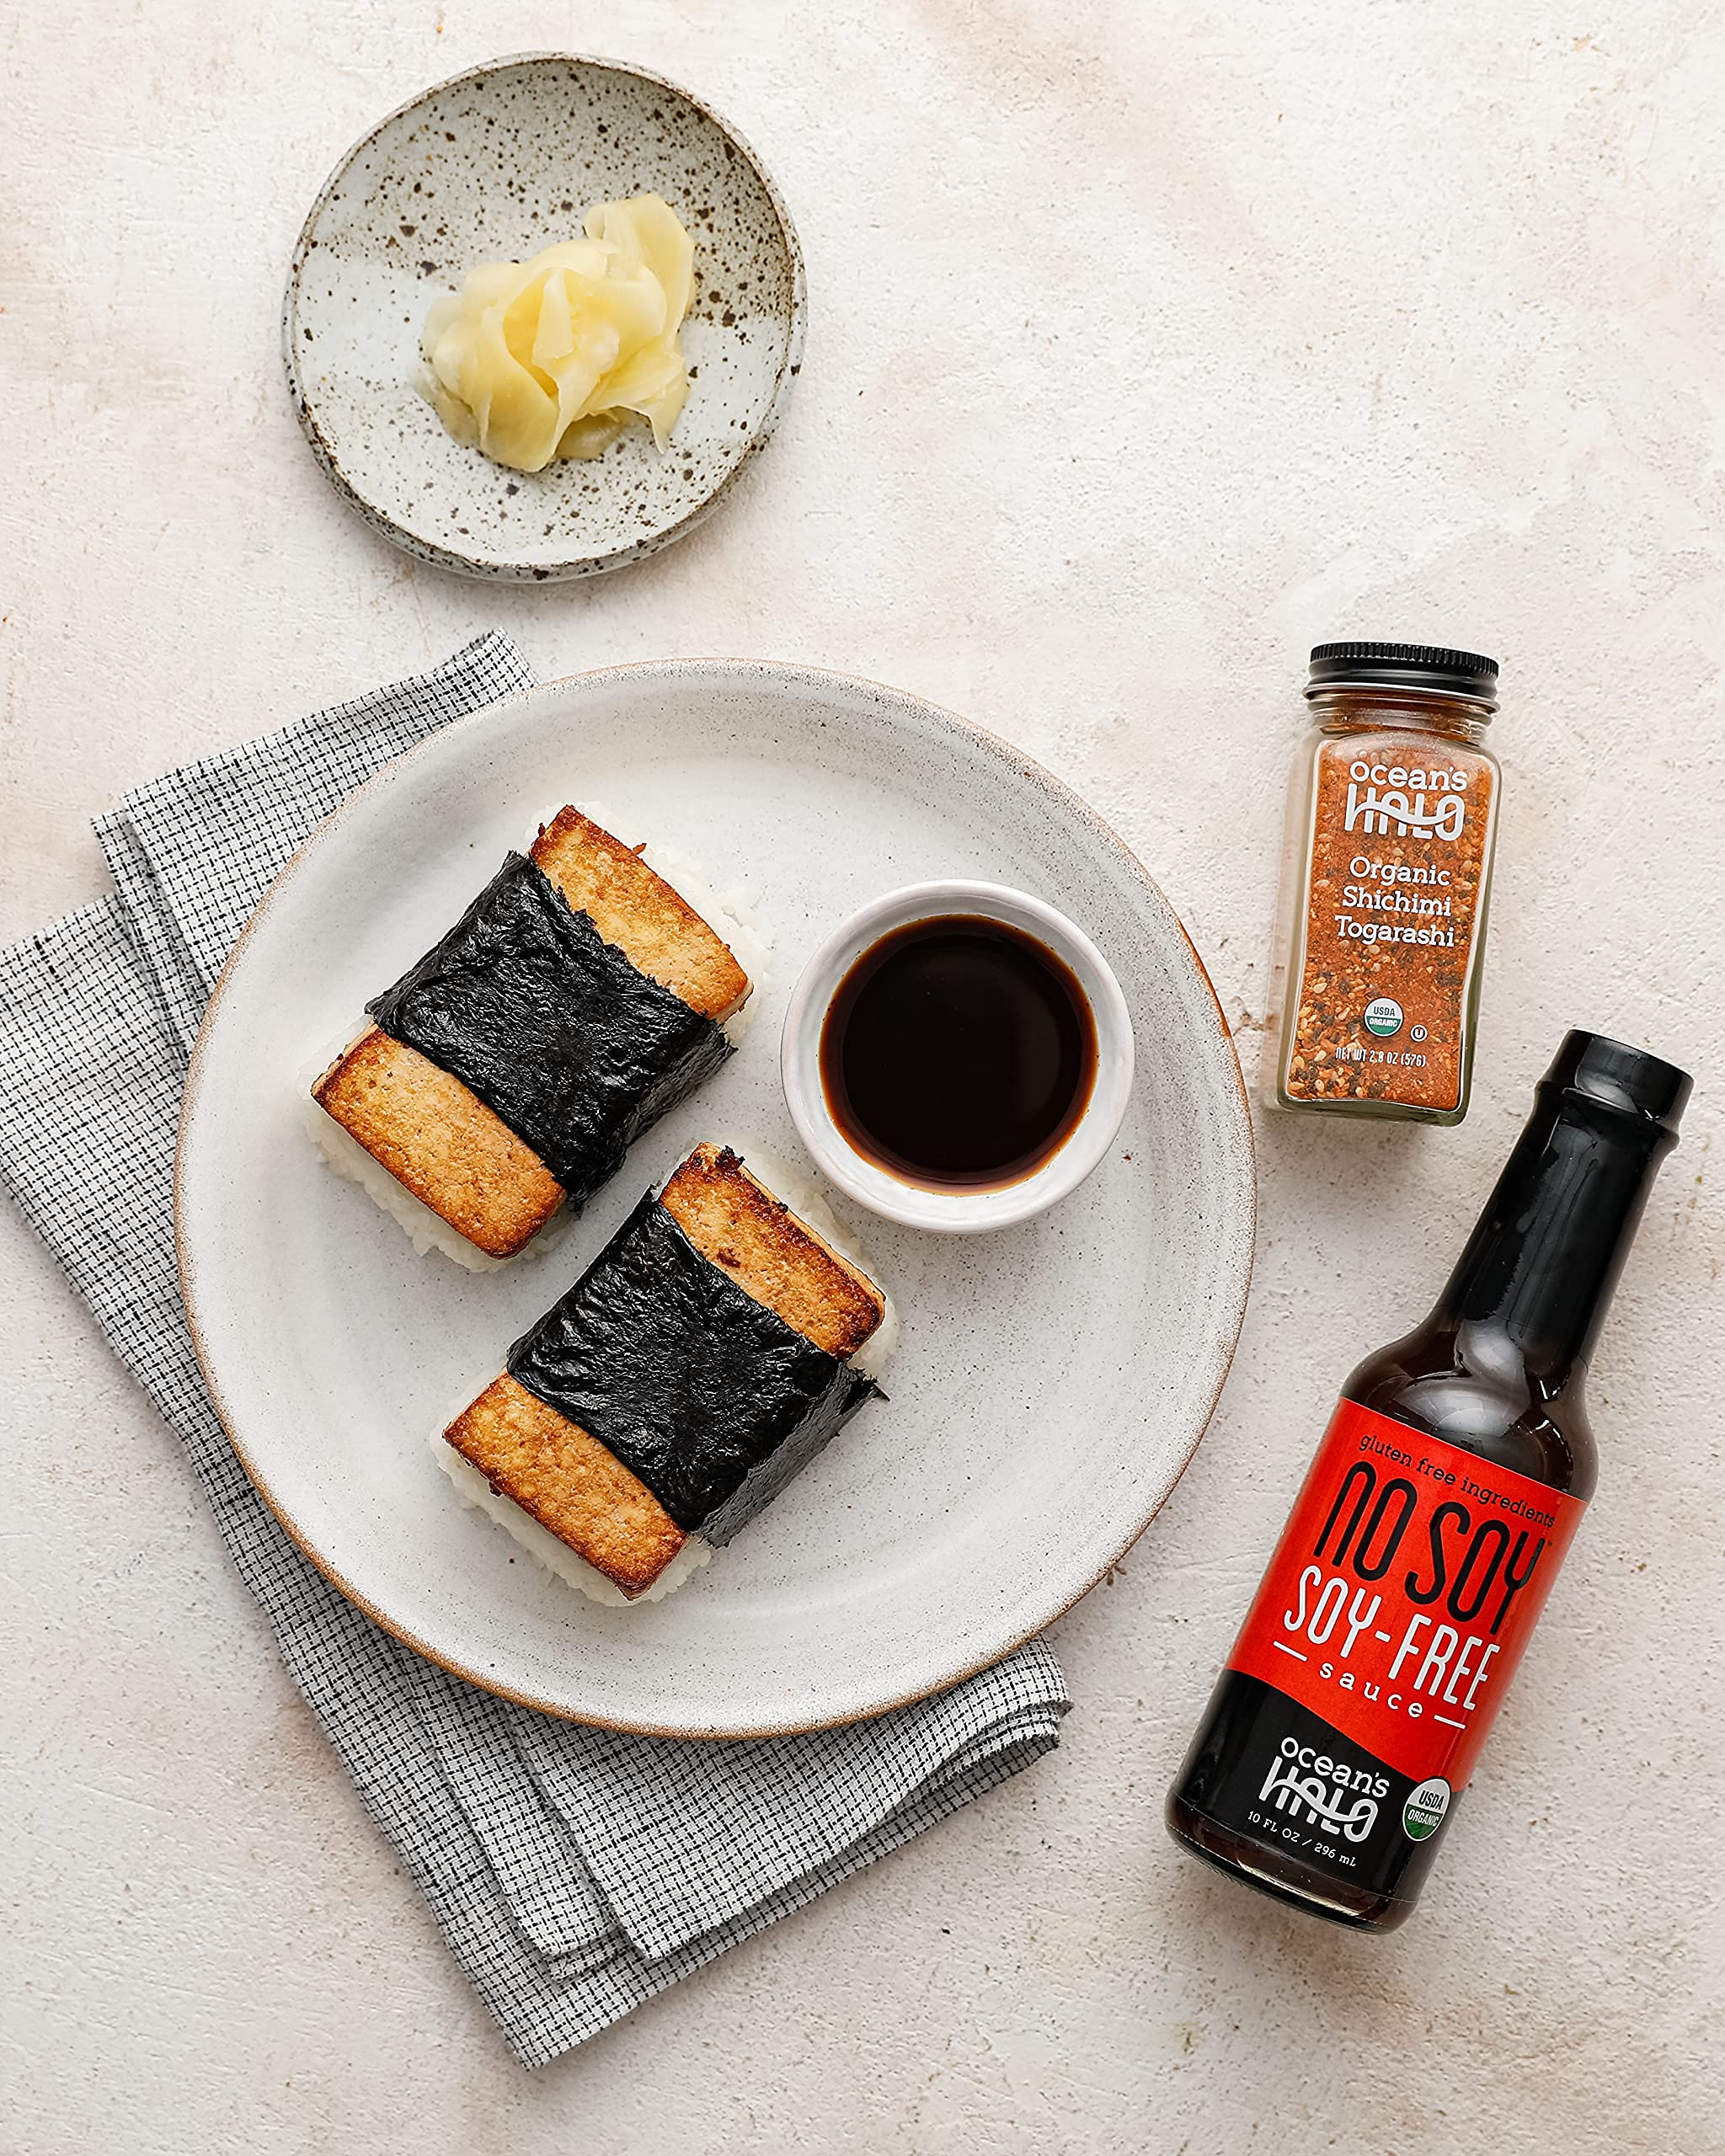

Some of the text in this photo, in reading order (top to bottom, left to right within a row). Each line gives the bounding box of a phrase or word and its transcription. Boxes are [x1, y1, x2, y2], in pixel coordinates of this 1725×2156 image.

[1349, 760, 1468, 792] ocean's
[1349, 856, 1451, 886] Organic
[1342, 885, 1452, 916] Shichimi
[1334, 915, 1455, 947] Togarashi
[1369, 1017, 1398, 1027] ORGANIC
[1373, 1006, 1396, 1017] USDA
[1335, 1046, 1351, 1060] NET
[1354, 1048, 1367, 1062] WT
[1369, 1049, 1385, 1064] 2.8
[1386, 1051, 1399, 1065] OZ
[1358, 1434, 1556, 1529] gluten free ingredients
[1404, 1501, 1546, 1636] SOY
[1284, 1565, 1500, 1710] SOY-FREE
[1319, 1662, 1423, 1718] sauce
[1280, 1737, 1391, 1798] ocean's
[1418, 1790, 1445, 1811] USDA
[1407, 1809, 1439, 1827] ORGANIC
[1247, 1811, 1357, 1867] 10 FL OZ / 296 mL
